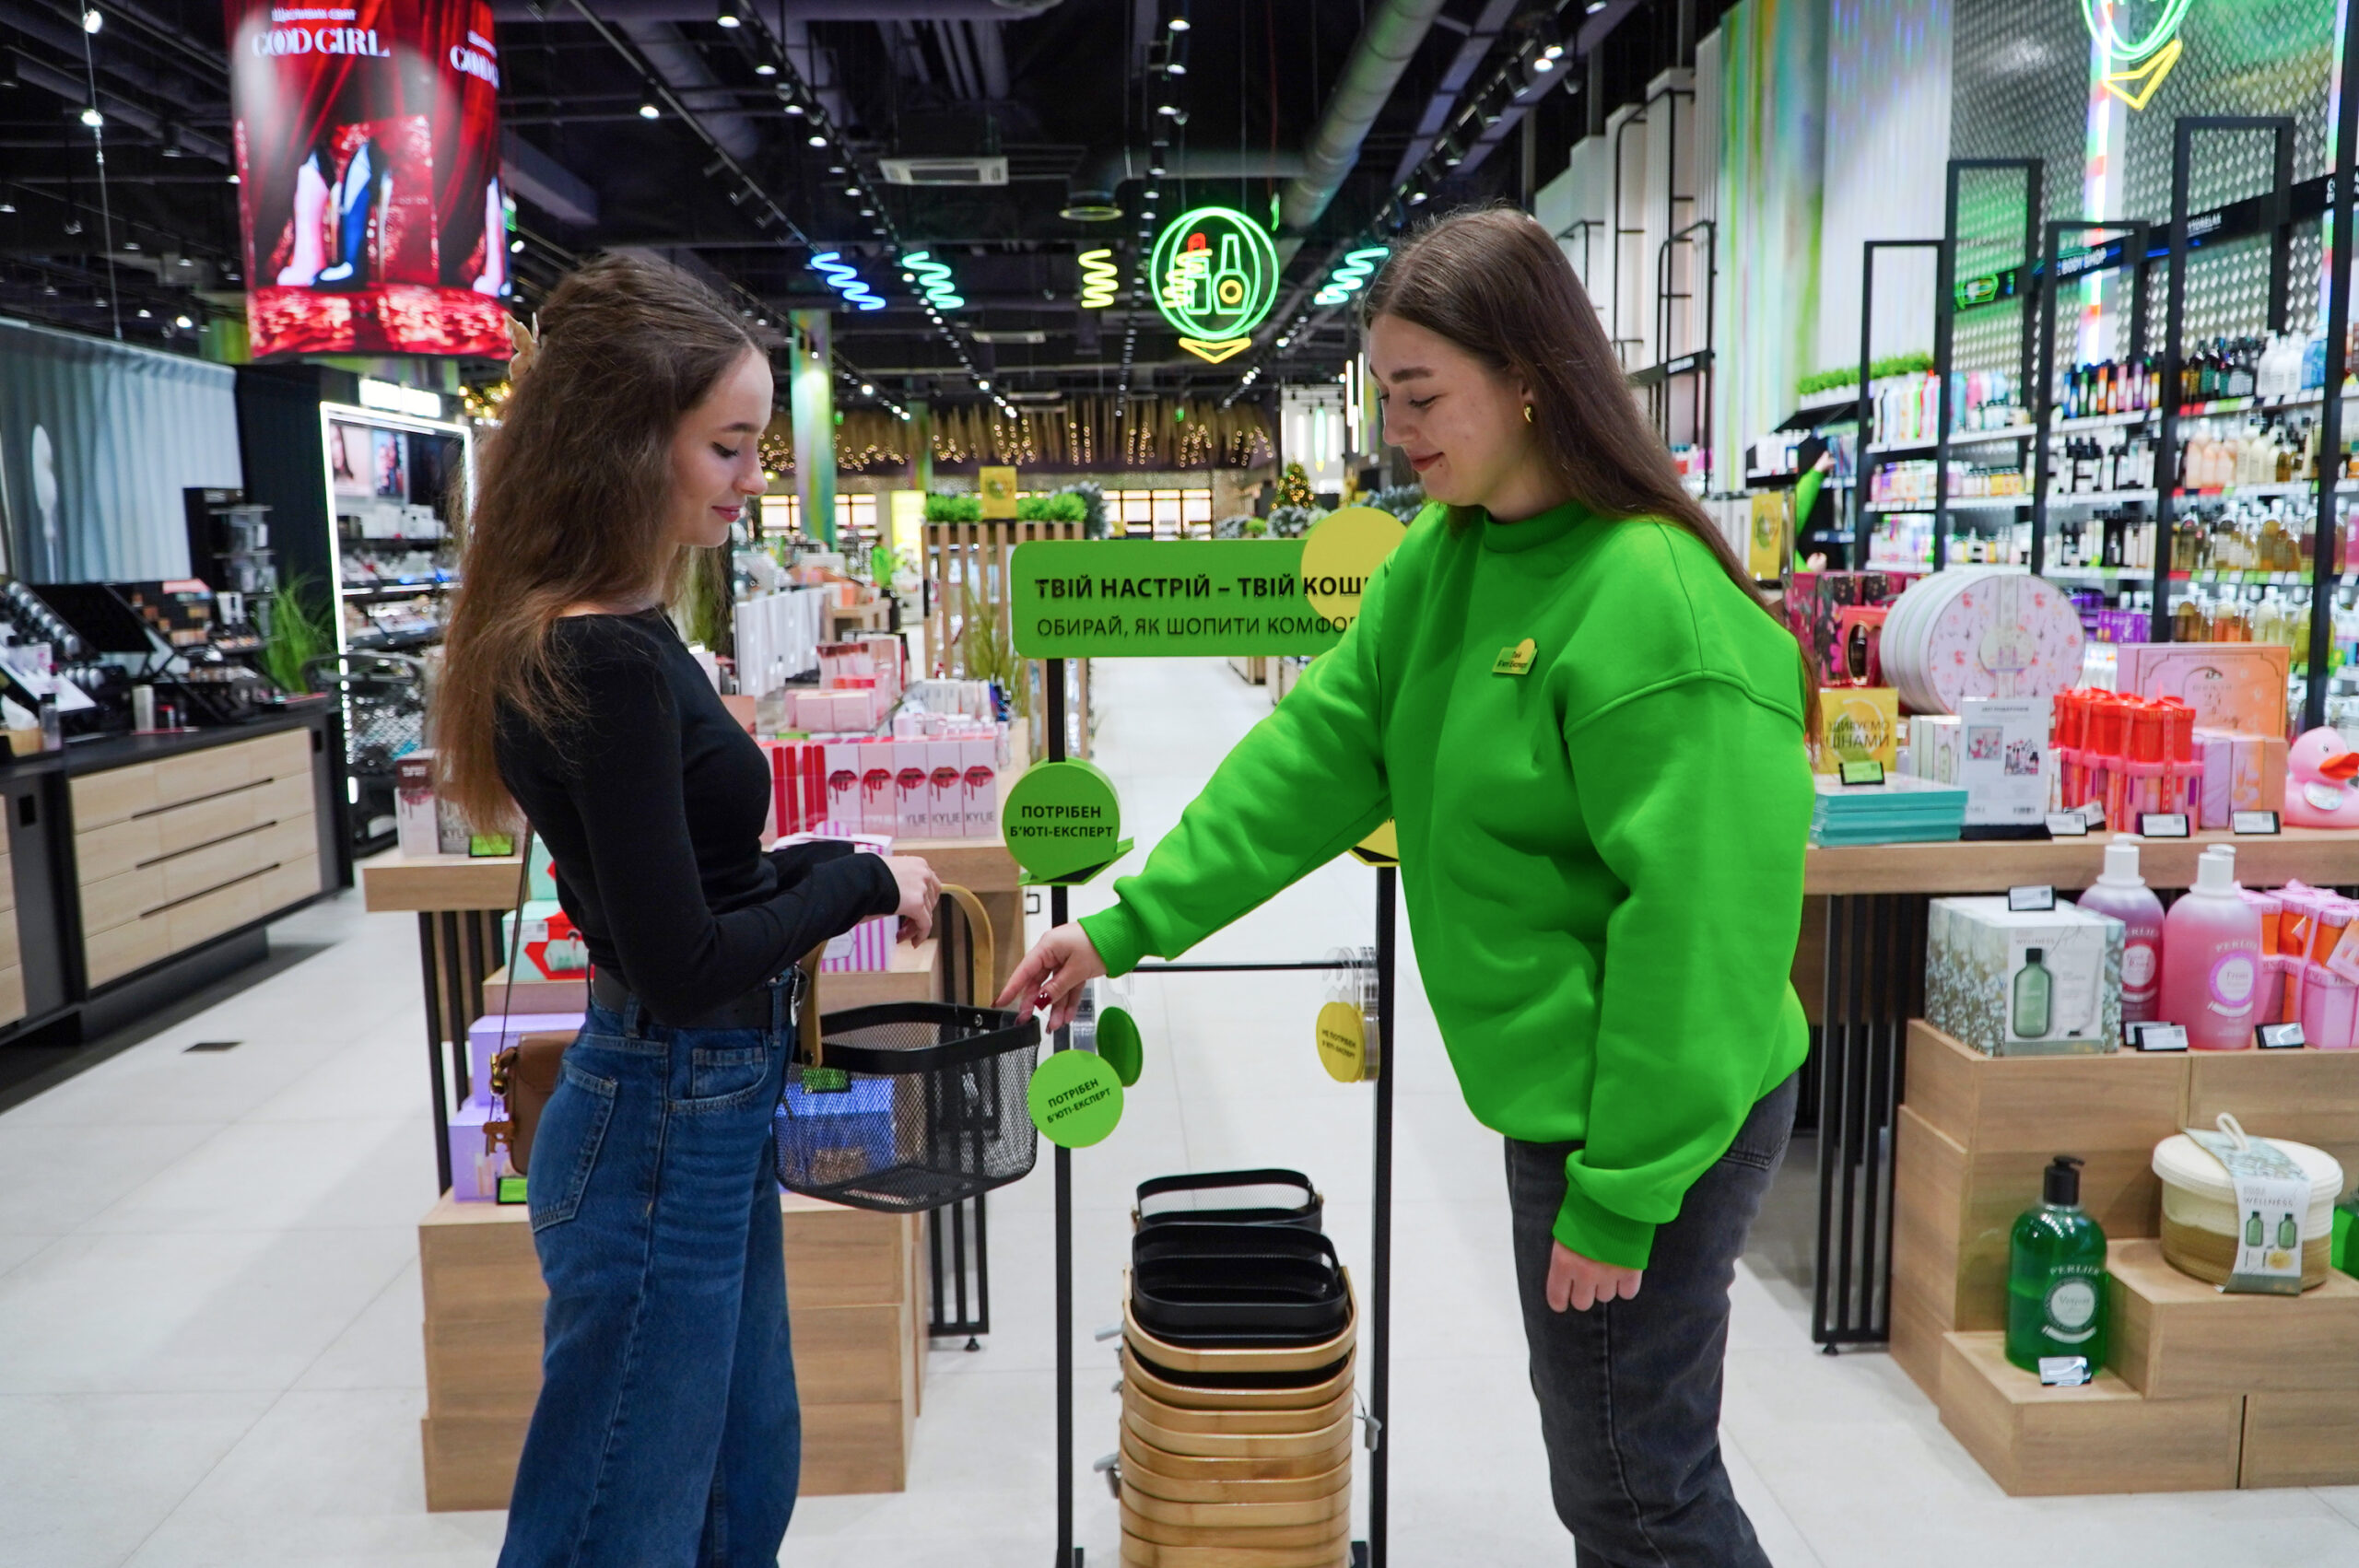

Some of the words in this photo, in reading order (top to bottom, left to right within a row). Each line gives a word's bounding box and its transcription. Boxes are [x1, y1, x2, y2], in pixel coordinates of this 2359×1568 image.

[314, 28, 391, 57] GIRL
[1035, 575, 1093, 598] ТВІЙ
[1101, 574, 1210, 598] НАСТРІЙ
[1238, 574, 1294, 597] ТВІЙ
[1304, 577, 1369, 596] КОШ
[1038, 616, 1128, 638] ОБИРАЙ,
[1134, 619, 1159, 636] ЯК
[1167, 618, 1260, 635] ШОПИТИ
[932, 812, 960, 825] KYLIE
[966, 811, 995, 825] KYLIE
[1021, 805, 1101, 819] ПОТРІБЕН
[1010, 826, 1113, 837] Б'ЮТІ-ЕКСПЕРТ
[1048, 1078, 1099, 1108] ПОТРІБЕН
